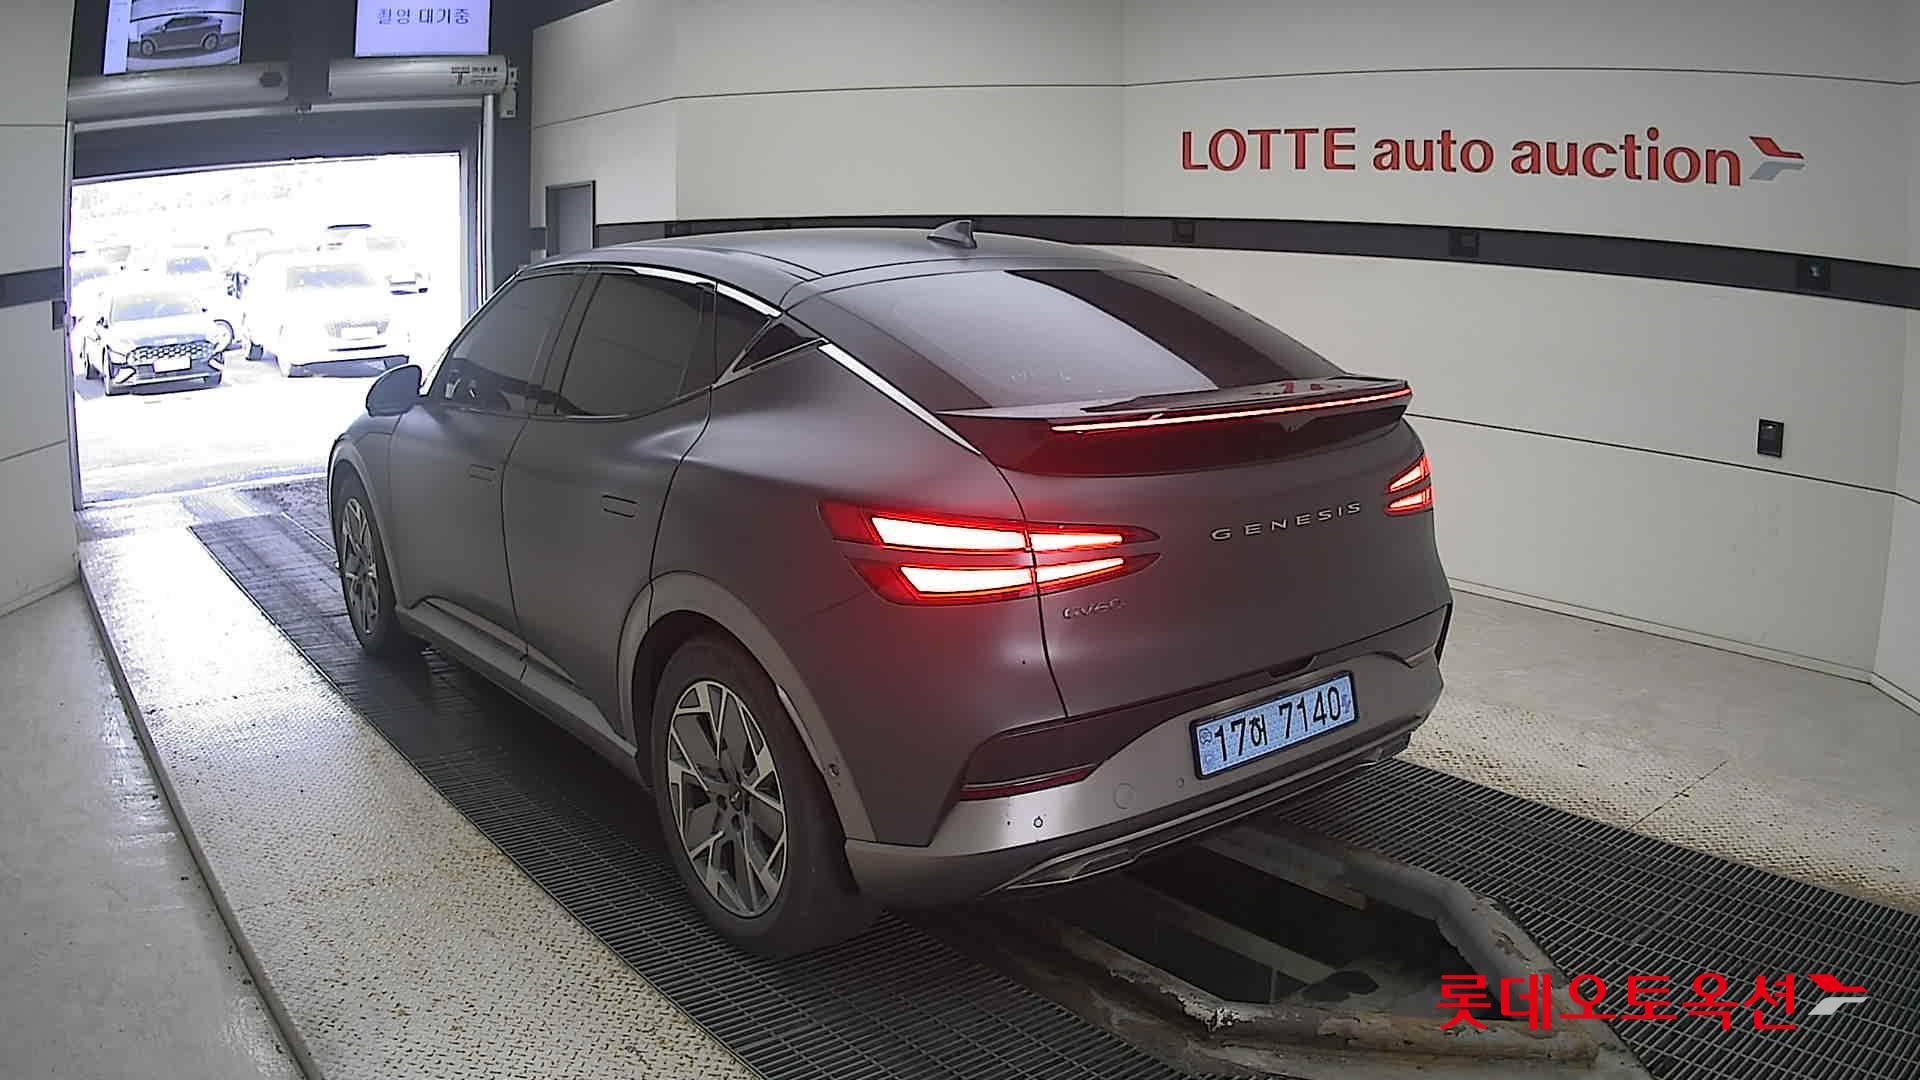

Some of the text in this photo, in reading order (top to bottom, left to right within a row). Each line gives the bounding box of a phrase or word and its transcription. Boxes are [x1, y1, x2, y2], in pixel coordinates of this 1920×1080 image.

[419, 8, 470, 24] 대기중
[1182, 127, 1742, 187] LOTTE auto auction
[1211, 501, 1361, 541] GENESIS
[1214, 686, 1342, 762] 17허 7140
